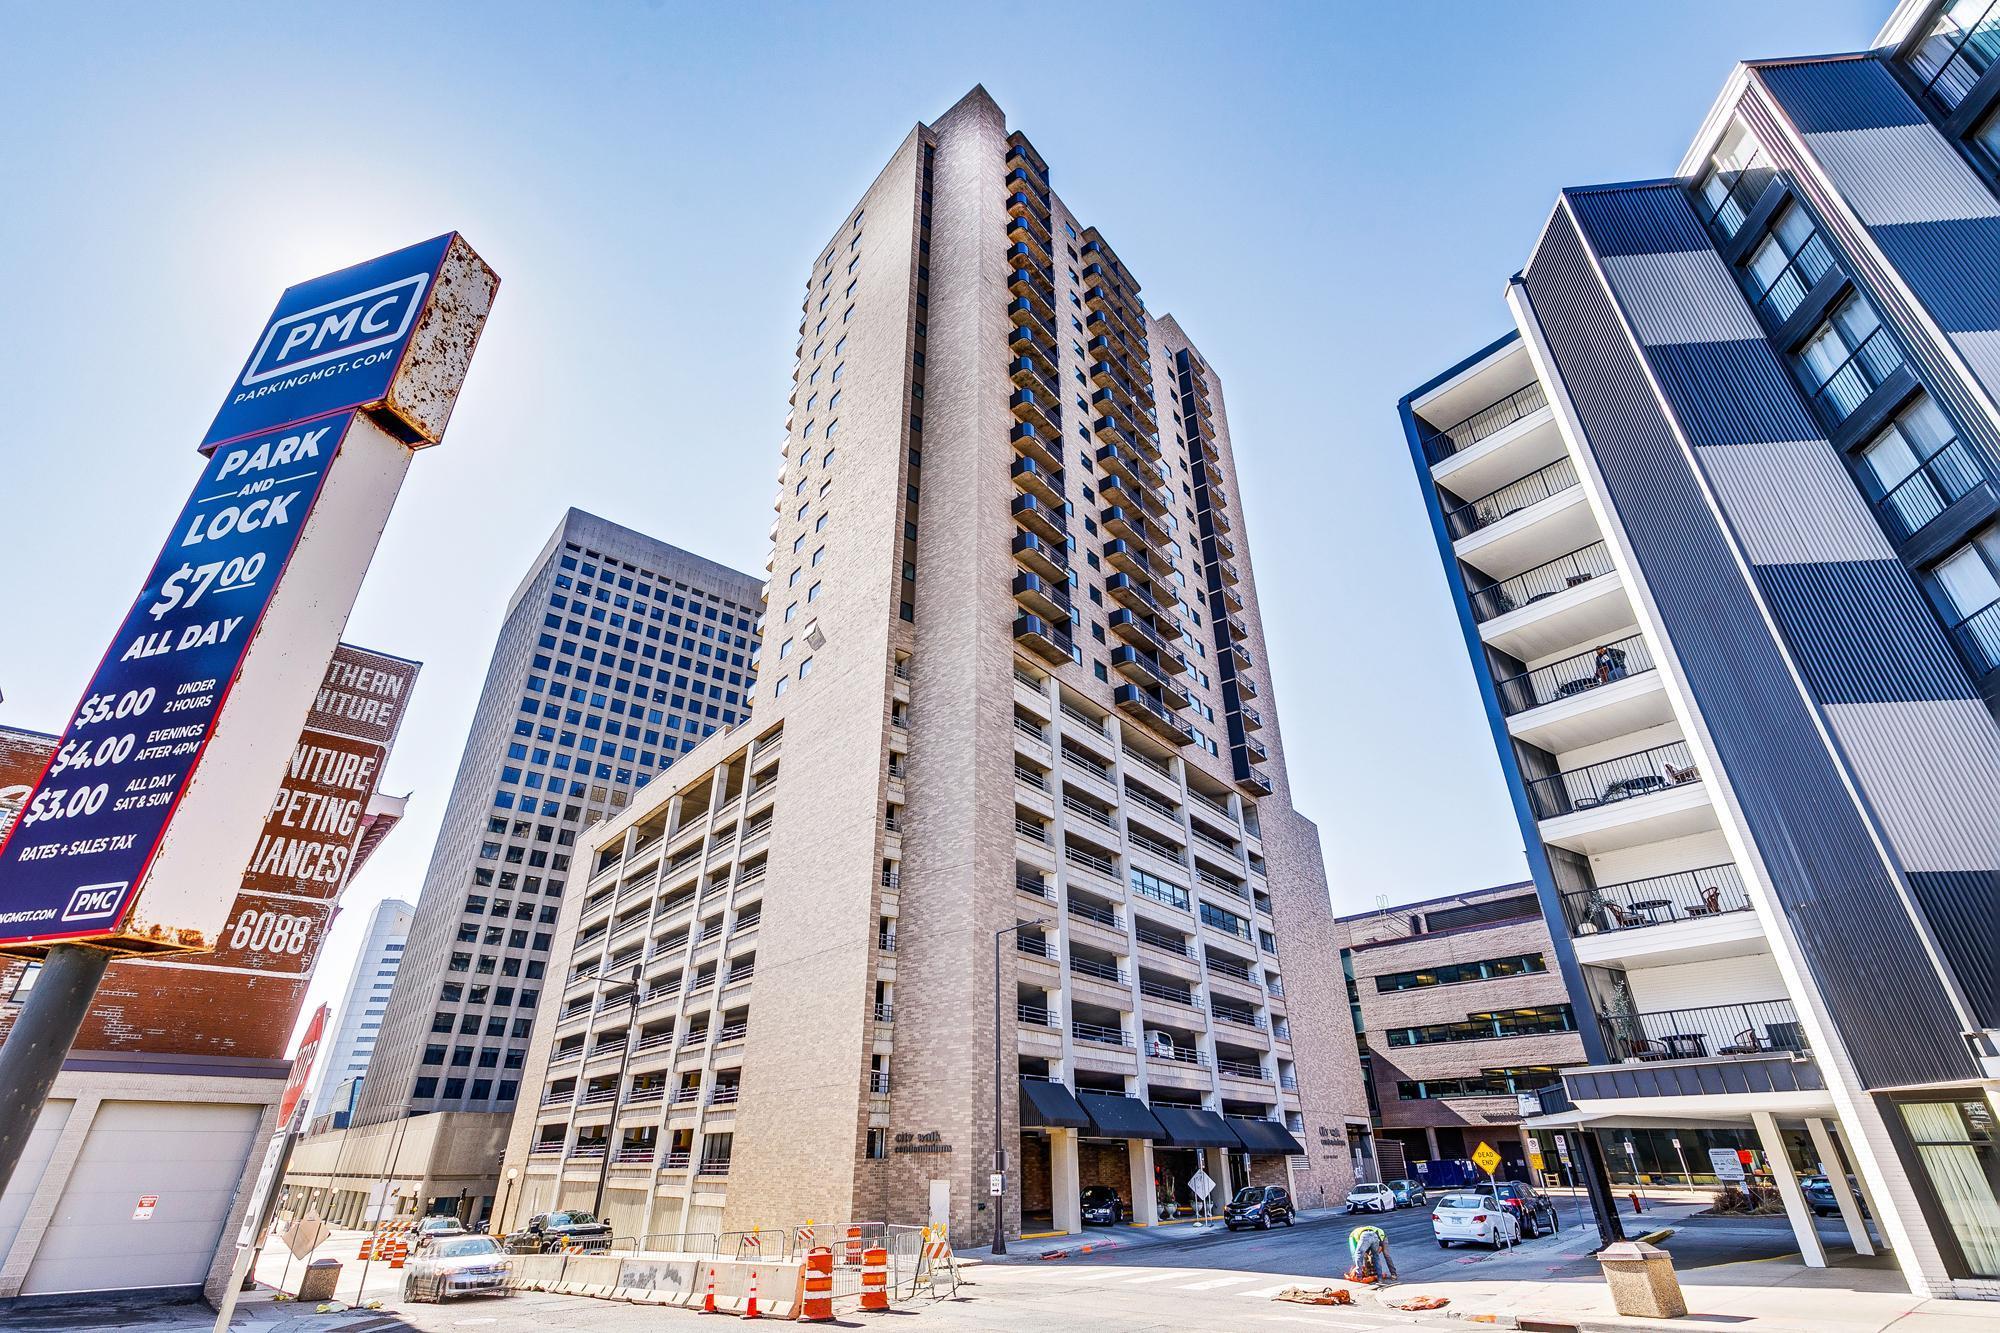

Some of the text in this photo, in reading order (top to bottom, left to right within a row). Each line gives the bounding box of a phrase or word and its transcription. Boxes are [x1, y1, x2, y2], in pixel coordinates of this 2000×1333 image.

[276, 296, 399, 362] PMC
[233, 349, 393, 405] PARKINGMGT.COM
[216, 426, 331, 481] PARK
[237, 477, 274, 498] AND
[181, 490, 301, 547] LOCK
[120, 616, 244, 662] ALL DAY
[176, 678, 216, 695] UNDER
[330, 660, 405, 699] THERN
[75, 686, 156, 730] $5.00
[163, 694, 214, 713] 2 HOURS
[135, 741, 200, 762] AFTER 4PM
[147, 723, 204, 743] EVENINGS
[50, 733, 136, 778] $4.00
[113, 792, 174, 812] SAT & SUN
[125, 773, 176, 792] ALL DAY
[23, 783, 109, 828] $3.00
[266, 787, 362, 836] PETING
[18, 833, 138, 862] RATES + SALES TAX
[248, 834, 349, 884] IANCES
[74, 890, 118, 912] PMC
[286, 1039, 319, 1093] STOP
